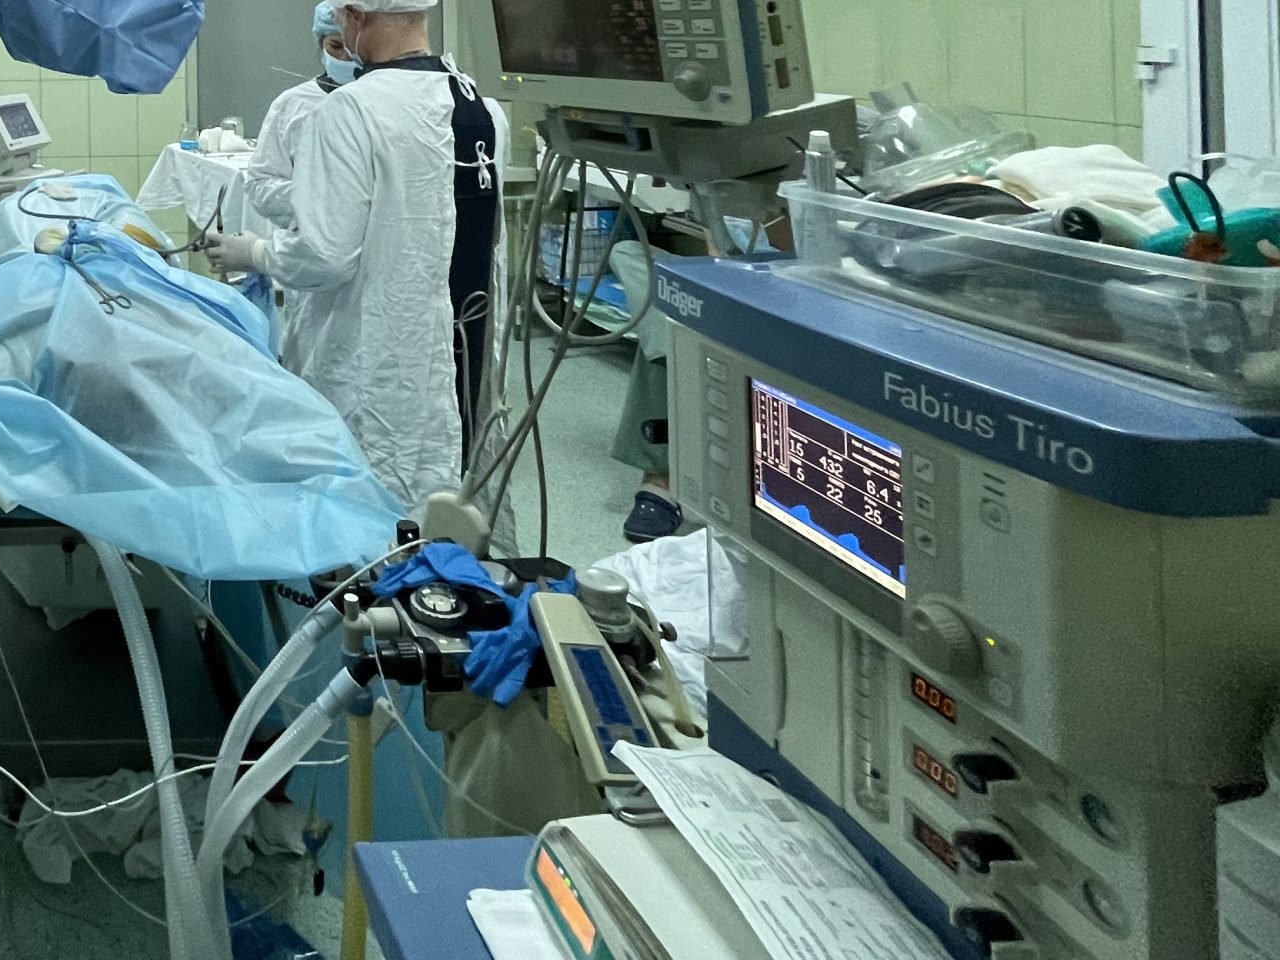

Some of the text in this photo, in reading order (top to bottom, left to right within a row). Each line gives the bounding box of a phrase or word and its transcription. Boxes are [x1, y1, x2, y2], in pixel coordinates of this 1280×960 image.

[657, 274, 703, 318] Dräger
[883, 371, 1094, 475] Fabius Tiro
[789, 439, 805, 458] 15
[796, 467, 806, 482] 5
[819, 455, 844, 479] 432
[826, 483, 844, 505] 22
[866, 480, 889, 503] 6.4
[864, 504, 883, 526] 25
